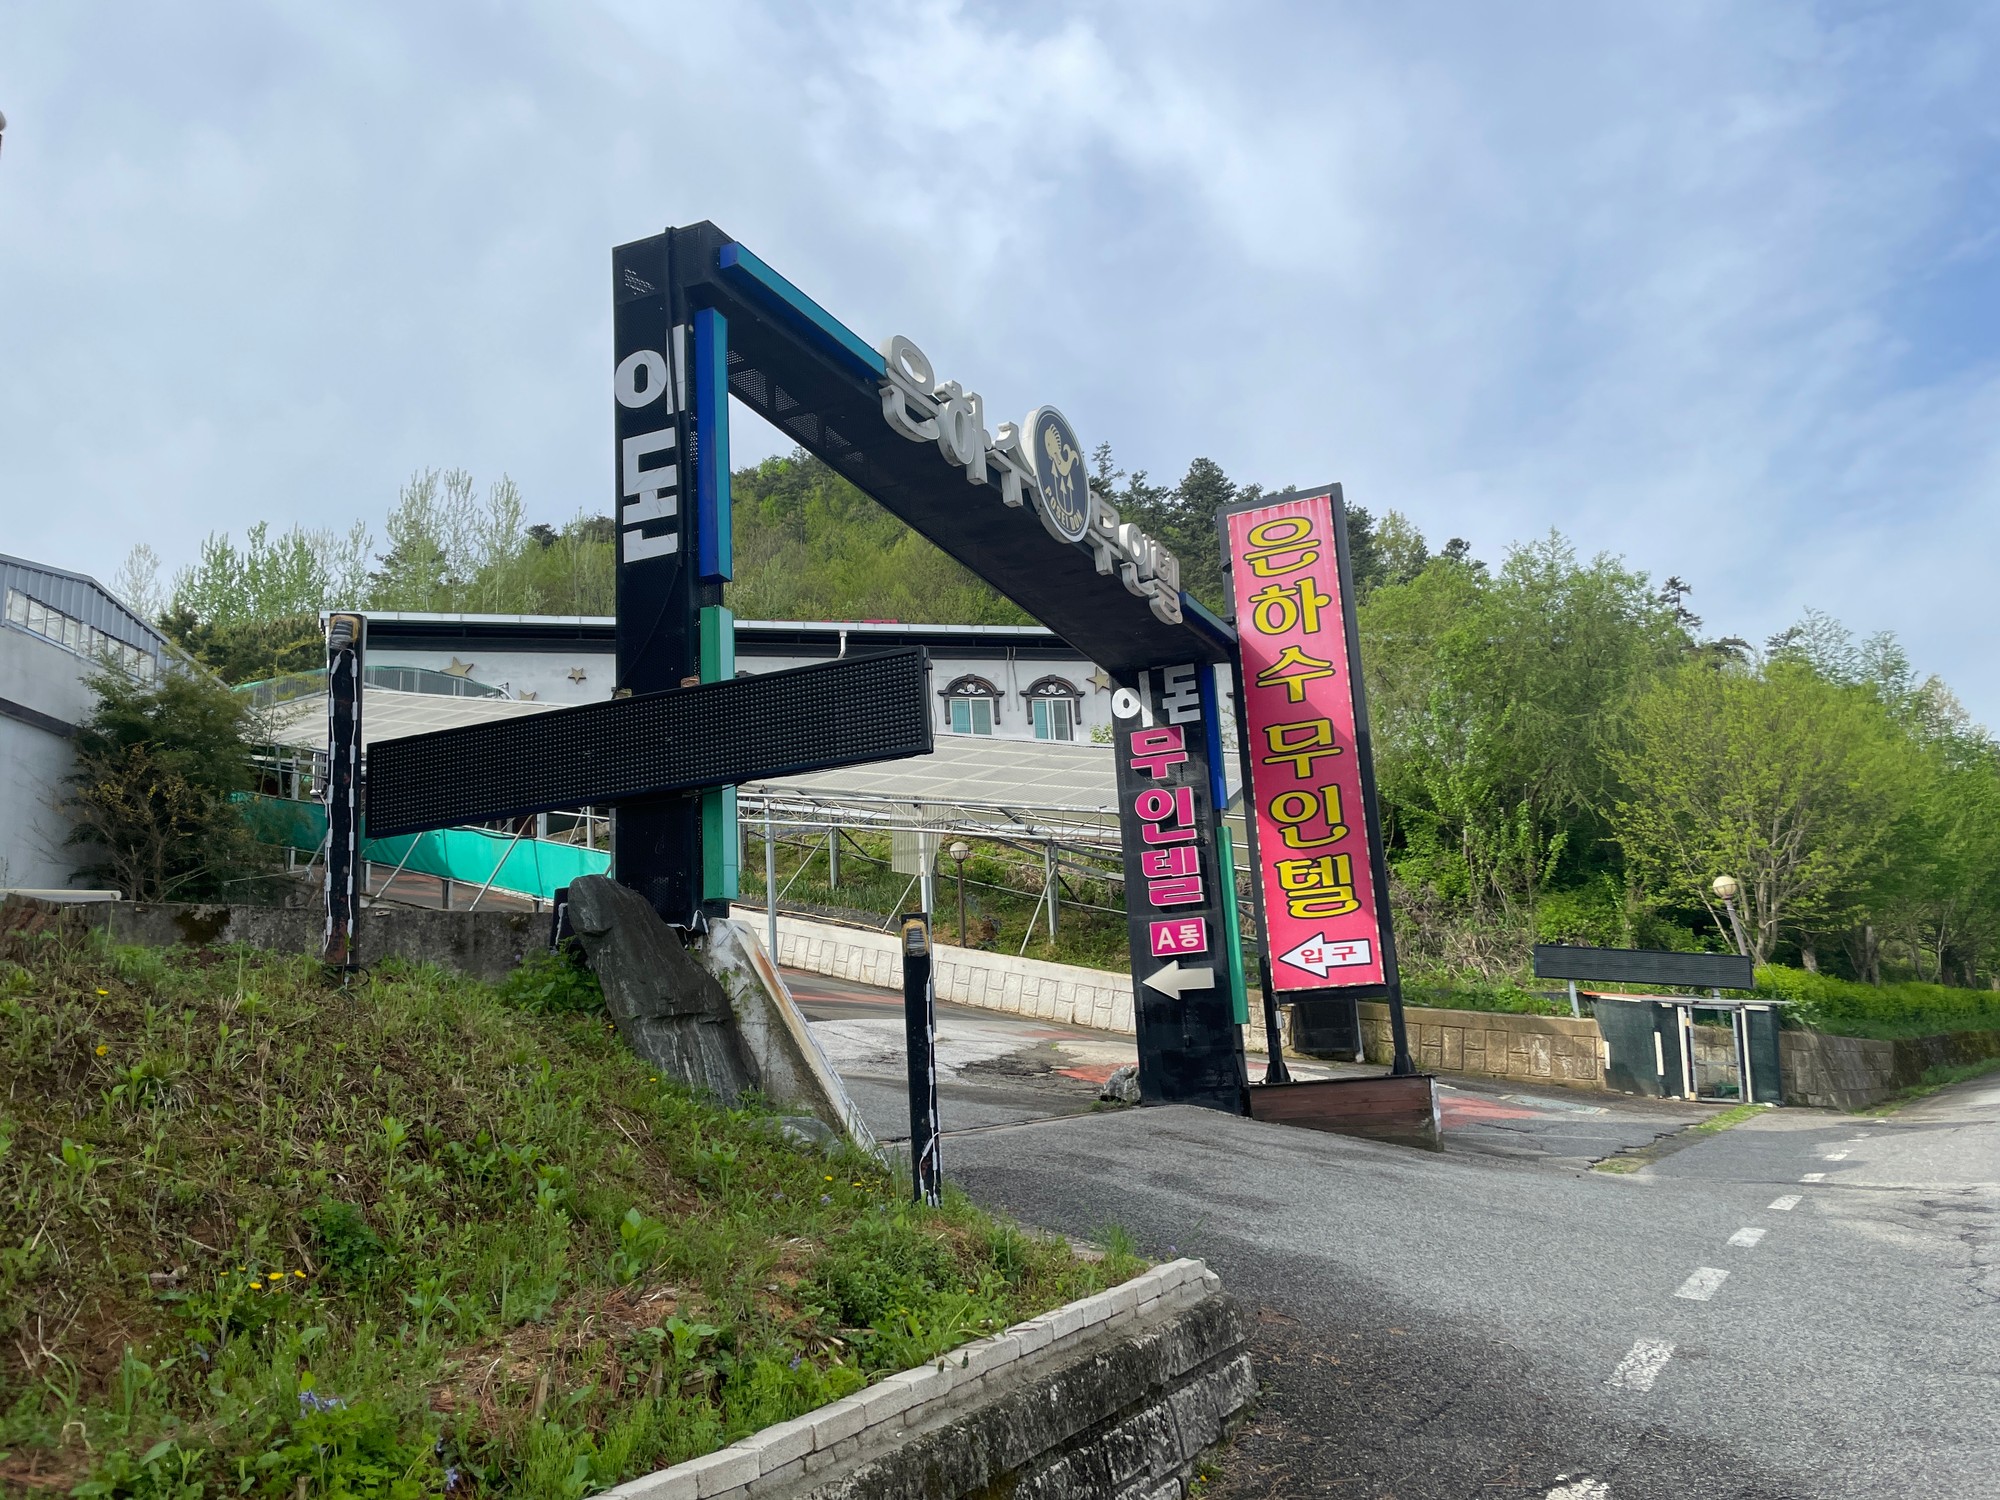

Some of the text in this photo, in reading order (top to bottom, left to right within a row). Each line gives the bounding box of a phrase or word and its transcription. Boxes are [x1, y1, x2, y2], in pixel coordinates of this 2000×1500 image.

[879, 335, 1038, 508] 은하수
[1044, 485, 1083, 531] POSEIDON
[1087, 491, 1184, 625] 무인텔
[1111, 663, 1201, 728] 이돈
[1130, 725, 1205, 907] 무인텔
[1156, 923, 1201, 951] A동
[1300, 945, 1358, 965] 입구
